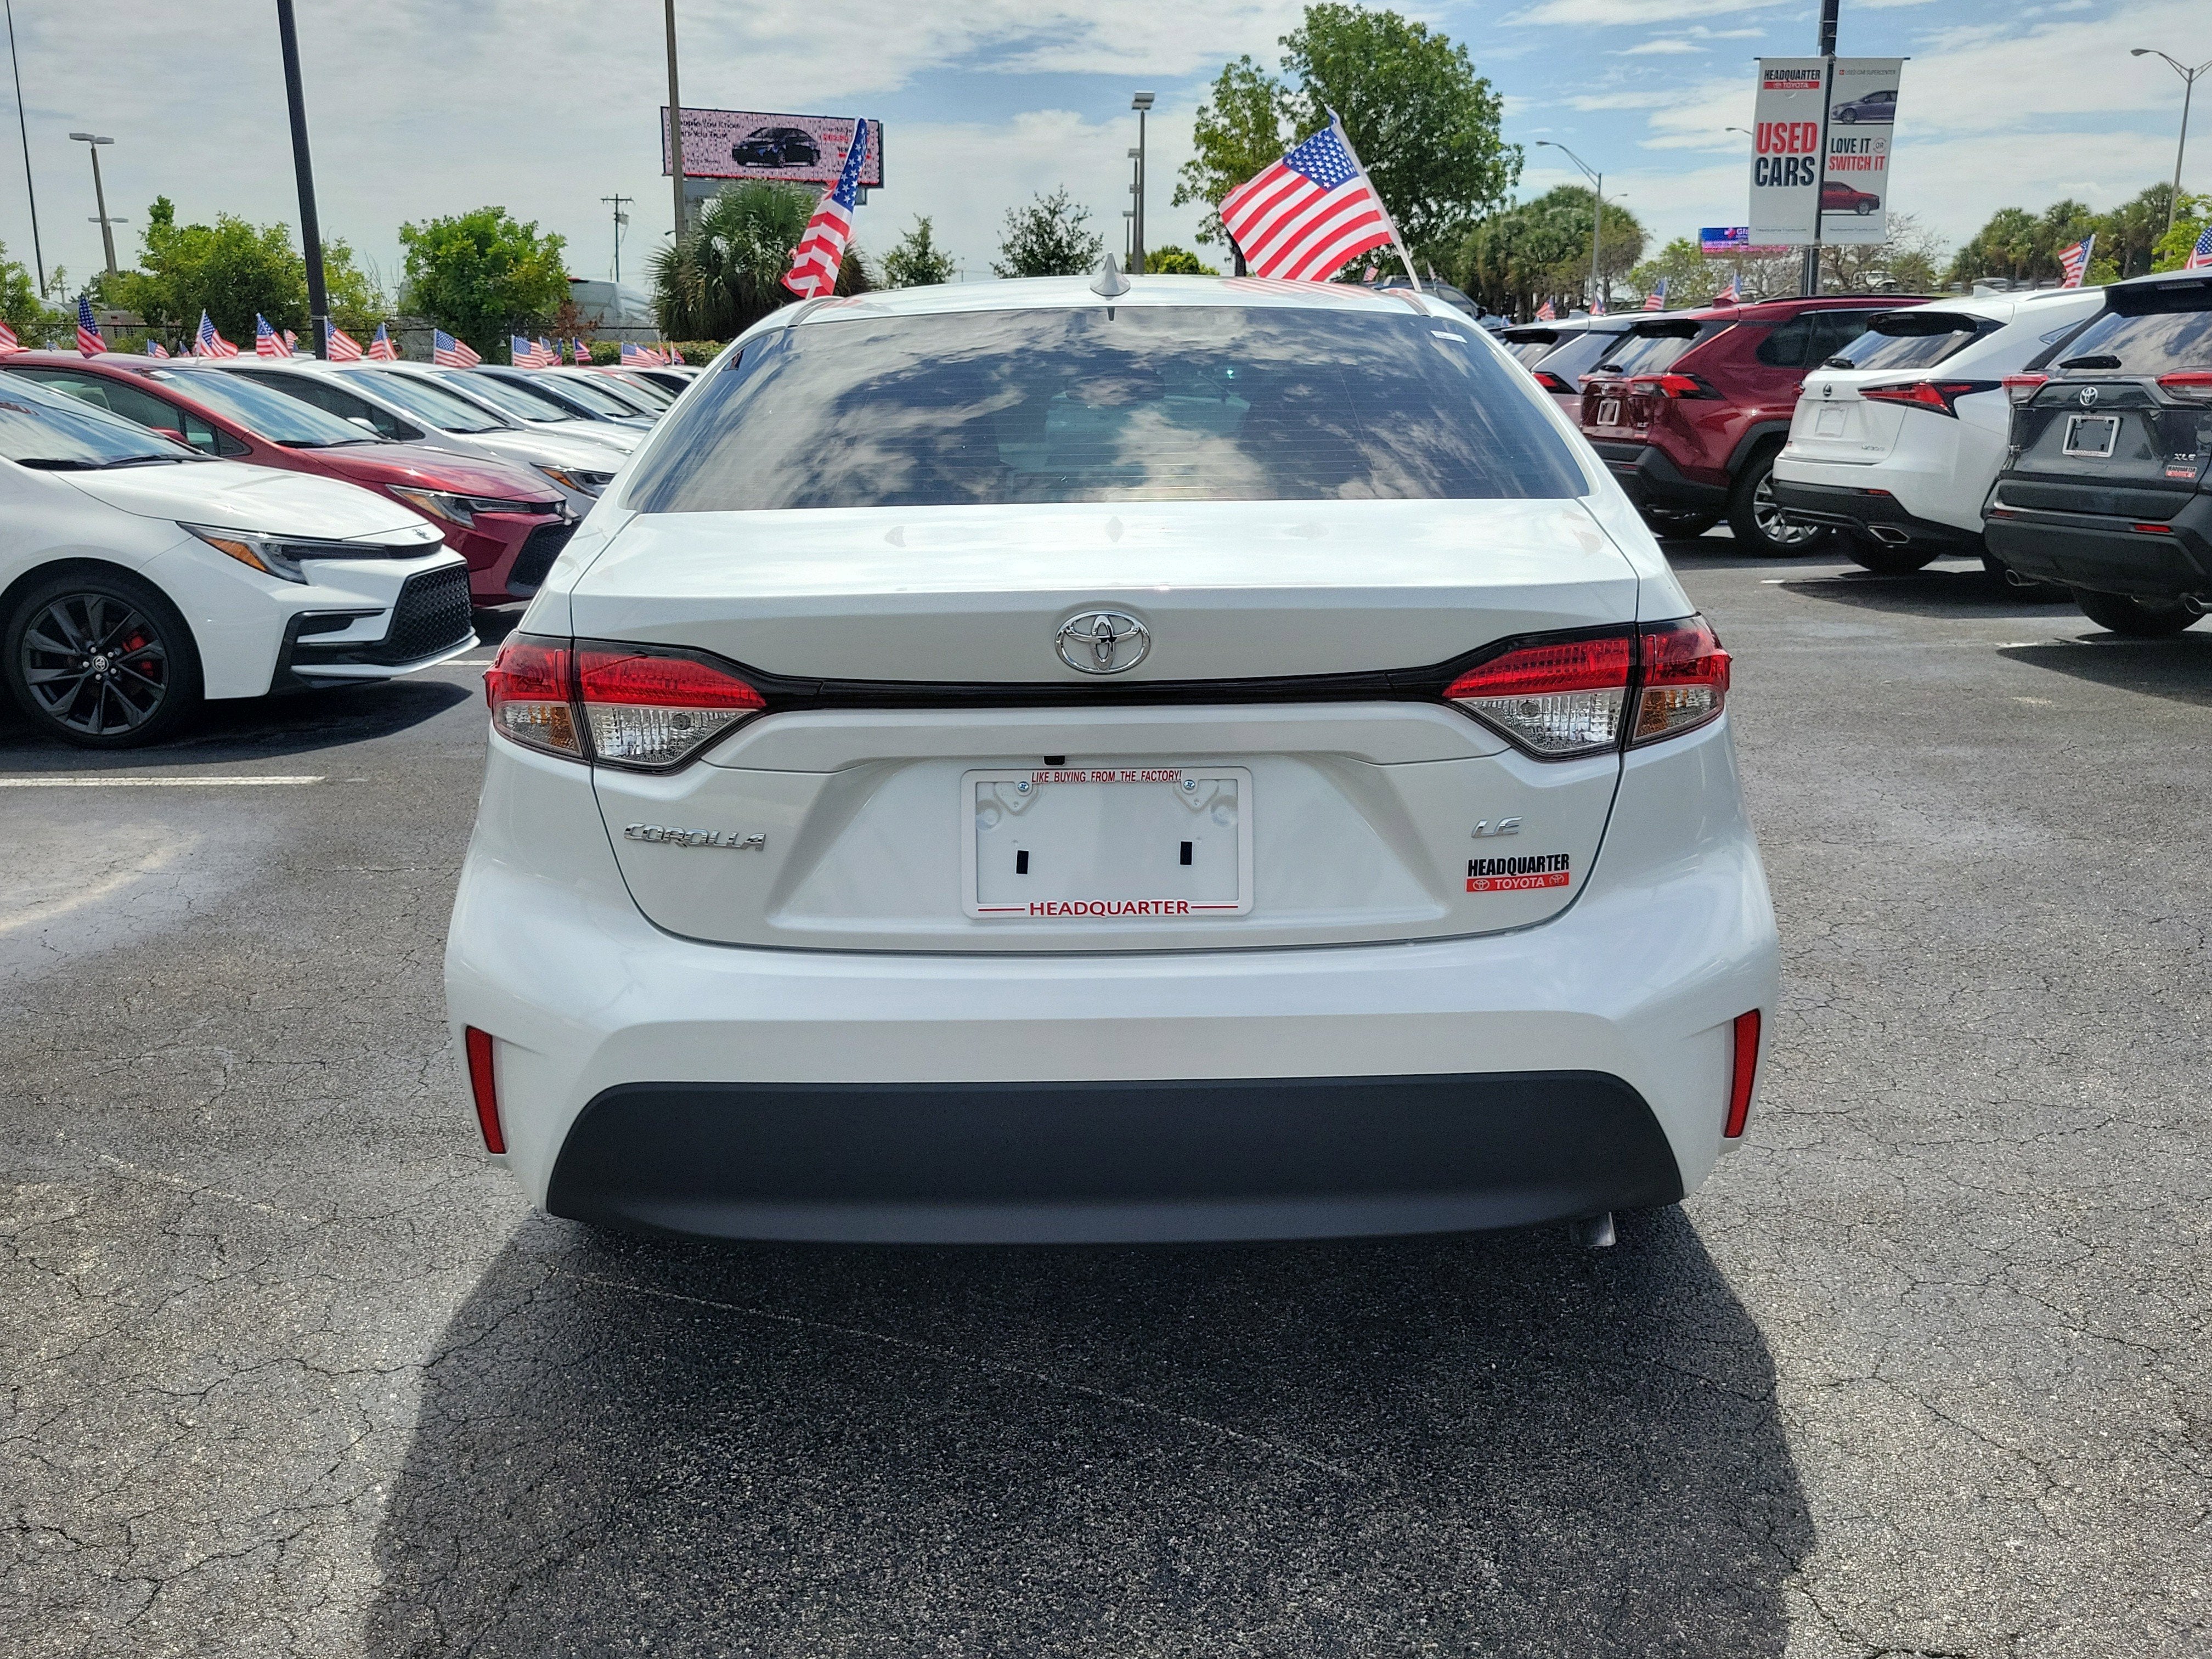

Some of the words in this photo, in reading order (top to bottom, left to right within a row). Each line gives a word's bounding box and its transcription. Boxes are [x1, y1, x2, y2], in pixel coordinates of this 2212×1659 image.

[1764, 70, 1820, 82] HEADQUARTER
[1757, 122, 1817, 154] USED
[1830, 138, 1857, 154] LOVE
[1860, 138, 1871, 154] IT
[1754, 156, 1815, 187] CARS
[1829, 156, 1871, 171] SWITCH
[1874, 156, 1886, 171] IT
[1032, 772, 1049, 783] LIKE
[1054, 771, 1086, 782] BUYING
[1091, 771, 1115, 782] FROM
[1120, 770, 1136, 782] THE
[1141, 770, 1182, 781] FACTORY!
[1471, 816, 1522, 838] LE
[623, 823, 766, 851] COROLLA
[1468, 853, 1570, 877] HEADQUARTER
[1494, 877, 1545, 890] TOYOTA
[1030, 900, 1190, 916] HEADQUARTER
